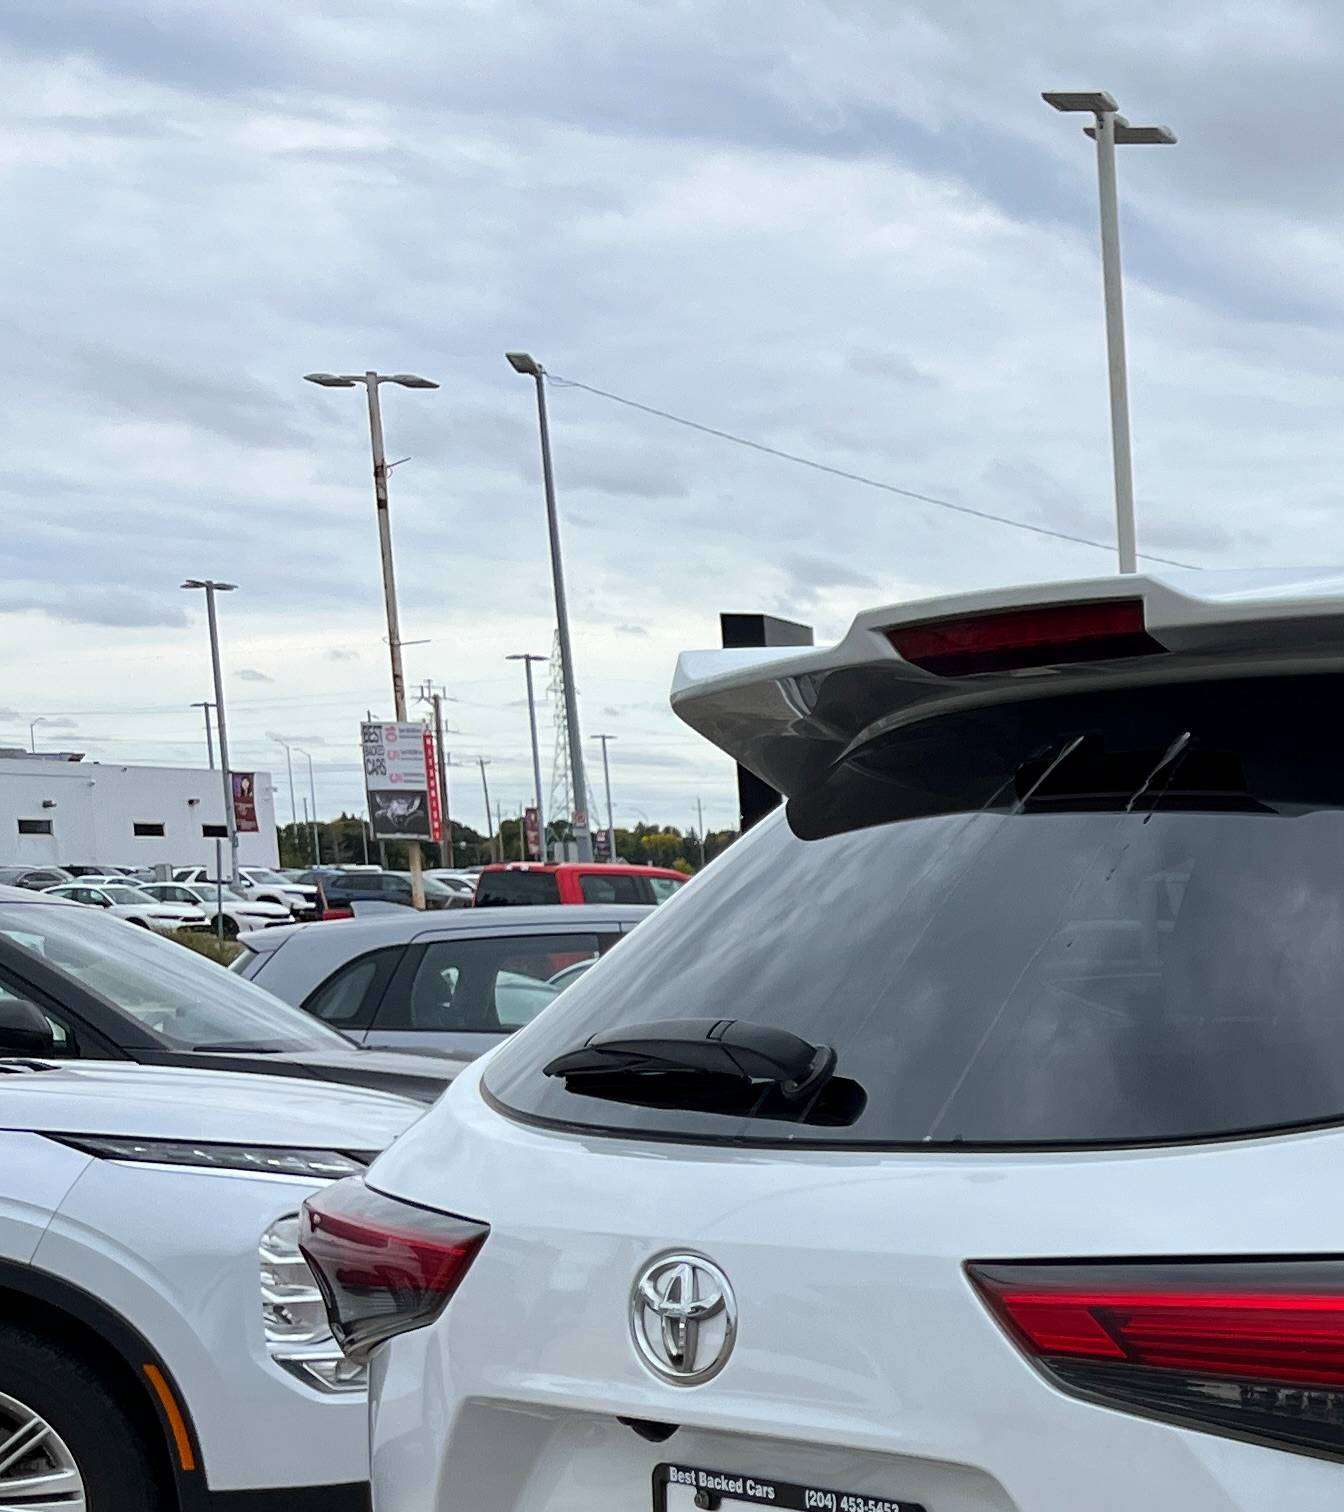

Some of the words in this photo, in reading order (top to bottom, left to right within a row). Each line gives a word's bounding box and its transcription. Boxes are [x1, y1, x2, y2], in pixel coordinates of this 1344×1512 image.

[669, 1466, 697, 1486] Best
[699, 1470, 743, 1494] Backed
[746, 1480, 776, 1499] Cars
[804, 1489, 837, 1512] (204)
